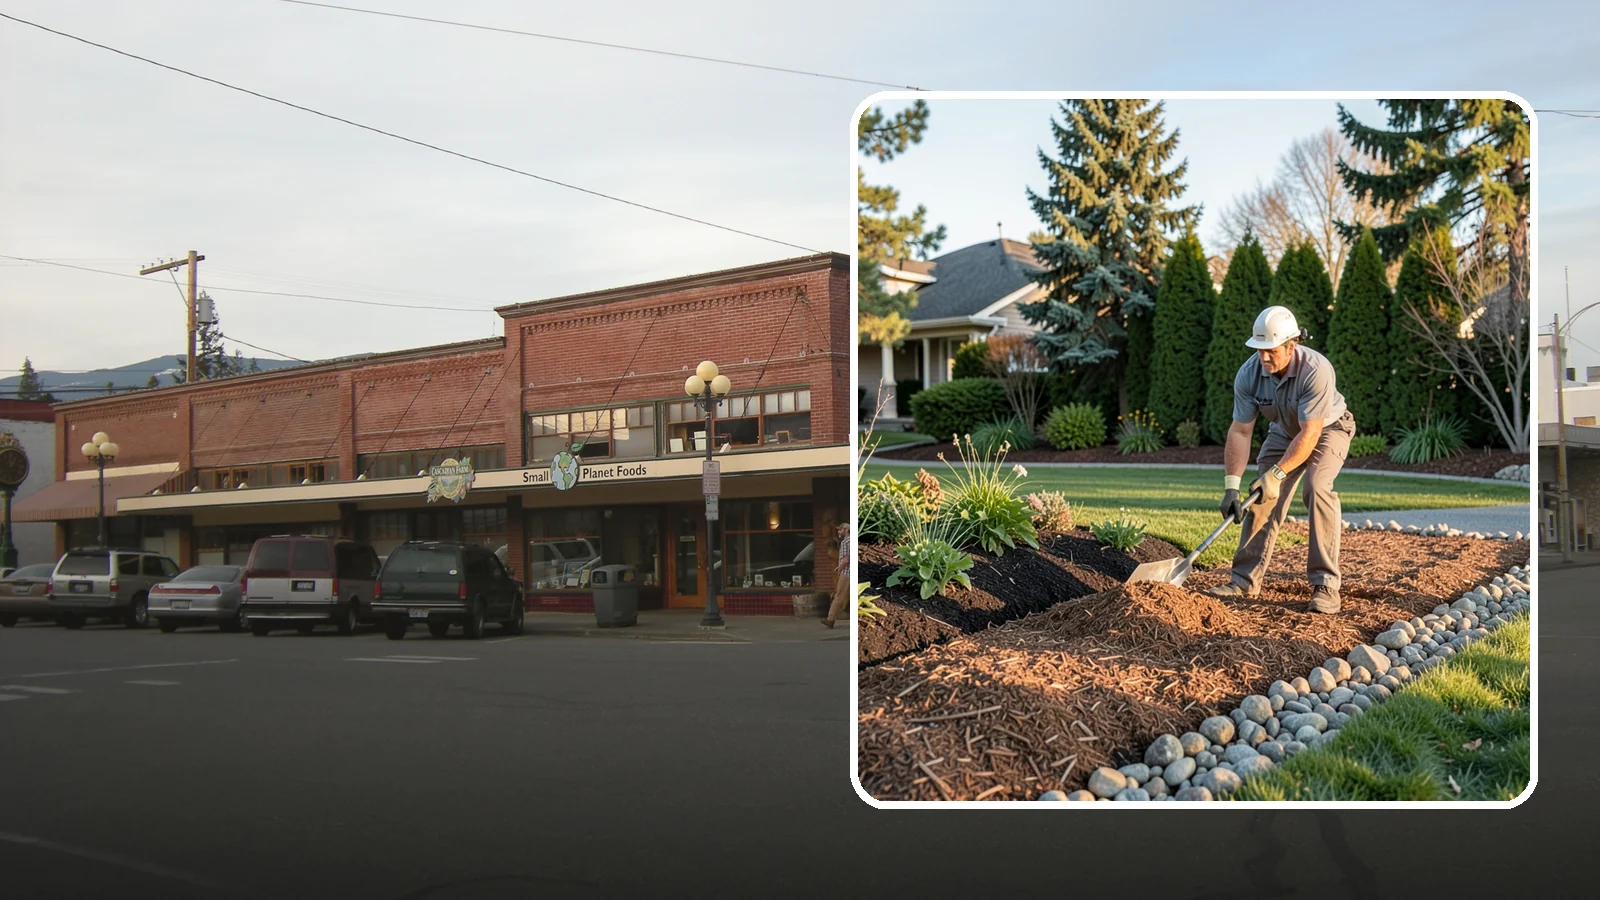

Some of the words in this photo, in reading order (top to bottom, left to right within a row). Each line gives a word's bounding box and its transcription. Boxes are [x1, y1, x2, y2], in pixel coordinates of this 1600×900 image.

[523, 471, 549, 483] Small
[583, 466, 614, 479] Planet
[617, 464, 647, 477] Foods
